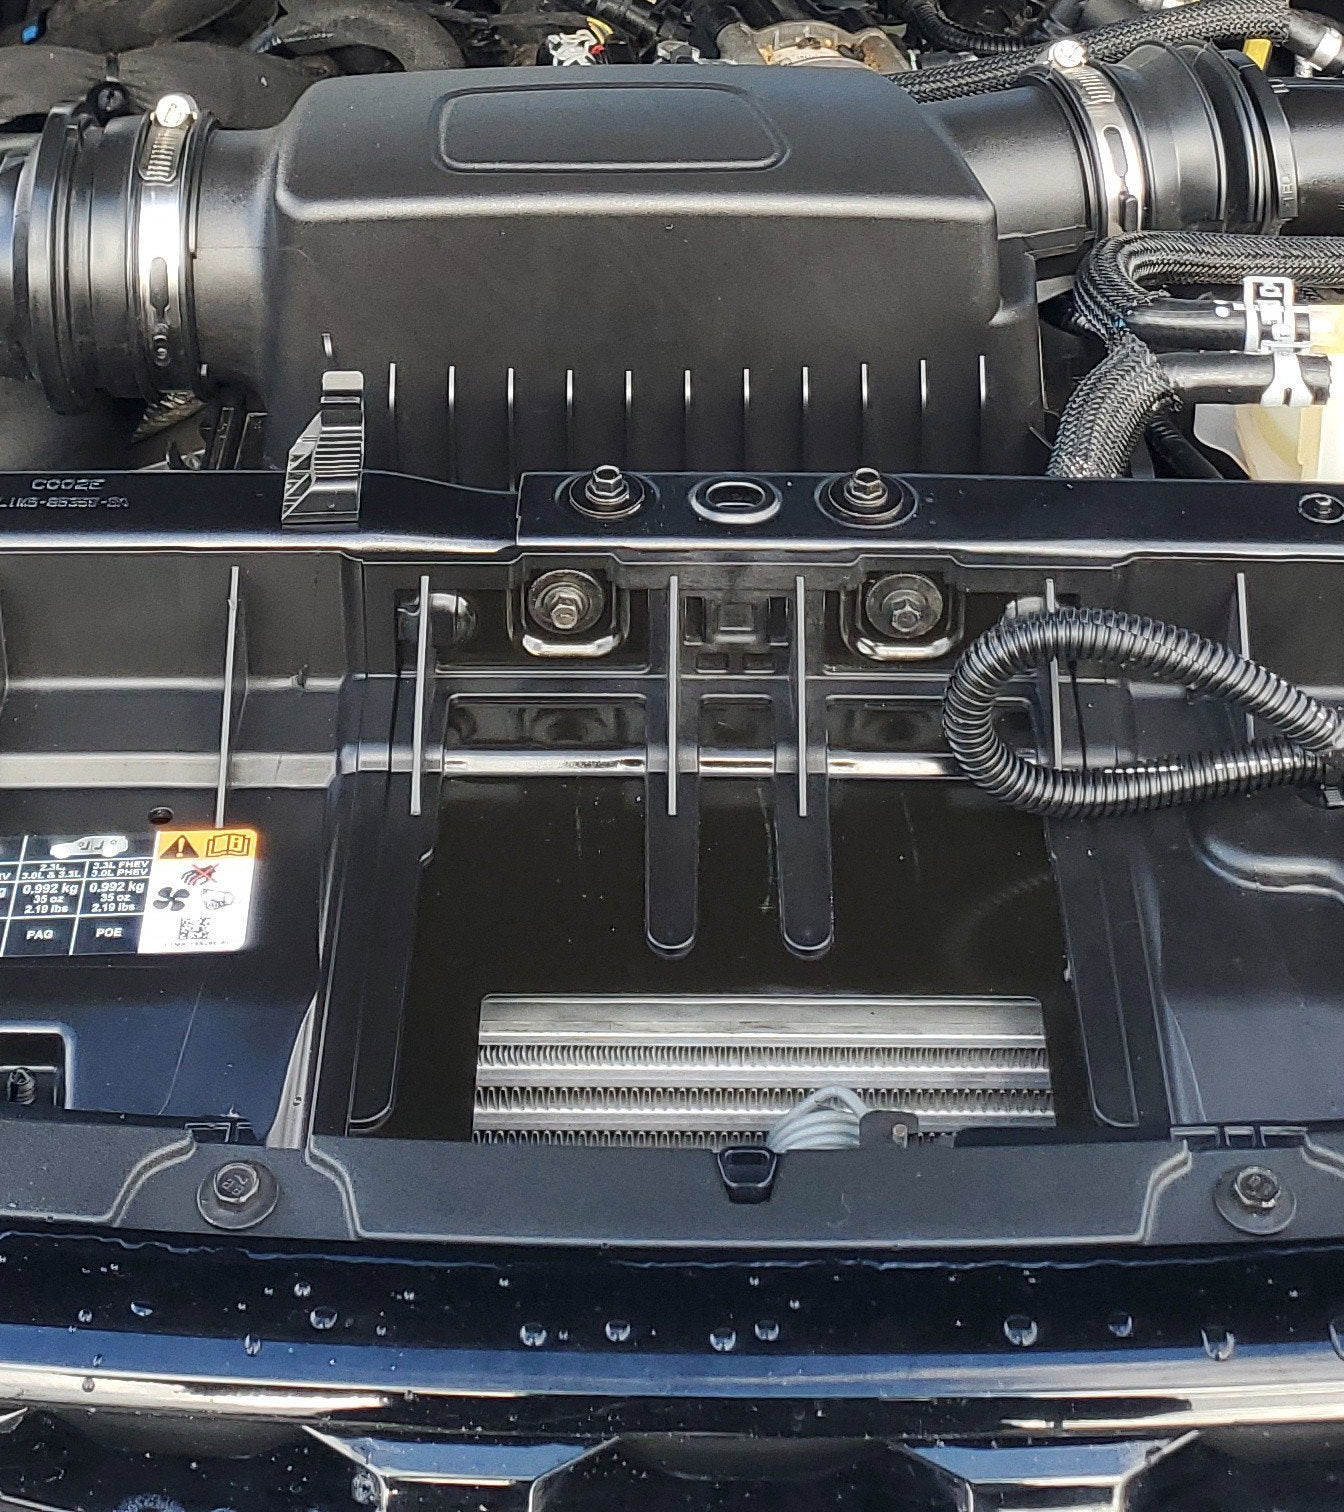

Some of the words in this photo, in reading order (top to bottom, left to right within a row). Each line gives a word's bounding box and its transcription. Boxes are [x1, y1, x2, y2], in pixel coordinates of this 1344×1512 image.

[22, 883, 58, 895] 0.992
[61, 883, 79, 895] kg
[89, 882, 125, 893] 0.992
[128, 881, 145, 893] kg
[33, 895, 48, 903] 35
[50, 895, 64, 903] oz
[100, 893, 115, 902] 35
[117, 894, 131, 902] oz
[24, 905, 48, 914] 2.19
[50, 904, 68, 913] lbs
[91, 903, 116, 912] 2.19
[117, 902, 135, 911] lbs
[26, 929, 54, 940] PAG
[96, 927, 123, 938] POE
